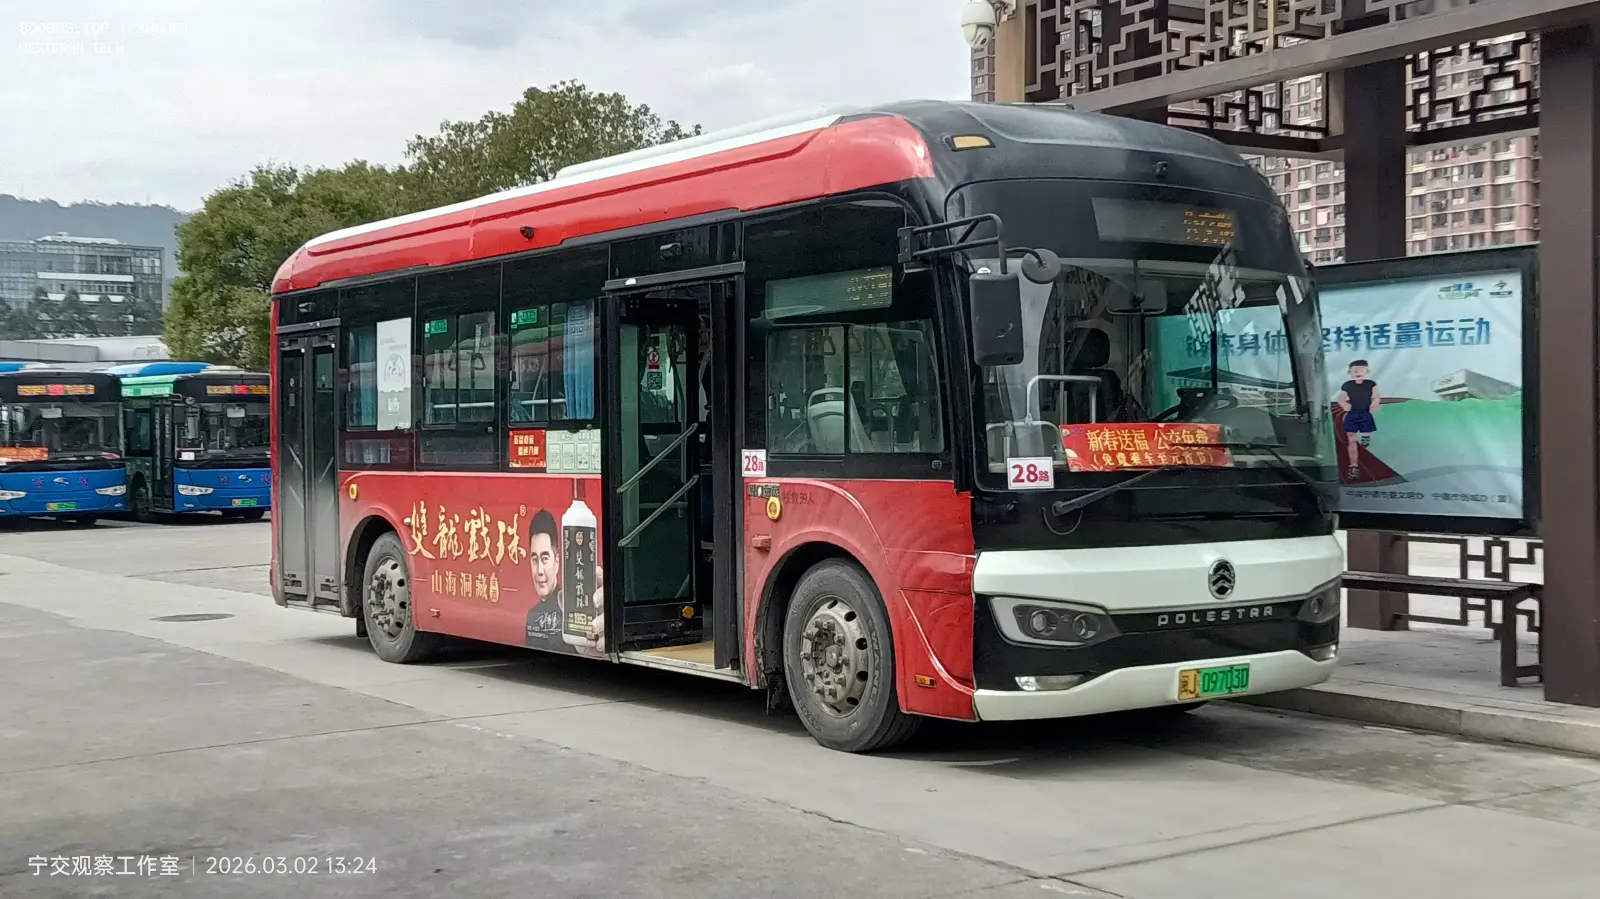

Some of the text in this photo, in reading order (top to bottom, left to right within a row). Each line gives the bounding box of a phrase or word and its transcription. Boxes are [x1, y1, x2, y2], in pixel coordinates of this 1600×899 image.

[1086, 429, 1150, 452] 新春送福
[1011, 463, 1050, 484] 28路
[1157, 606, 1273, 627] POLESTAR
